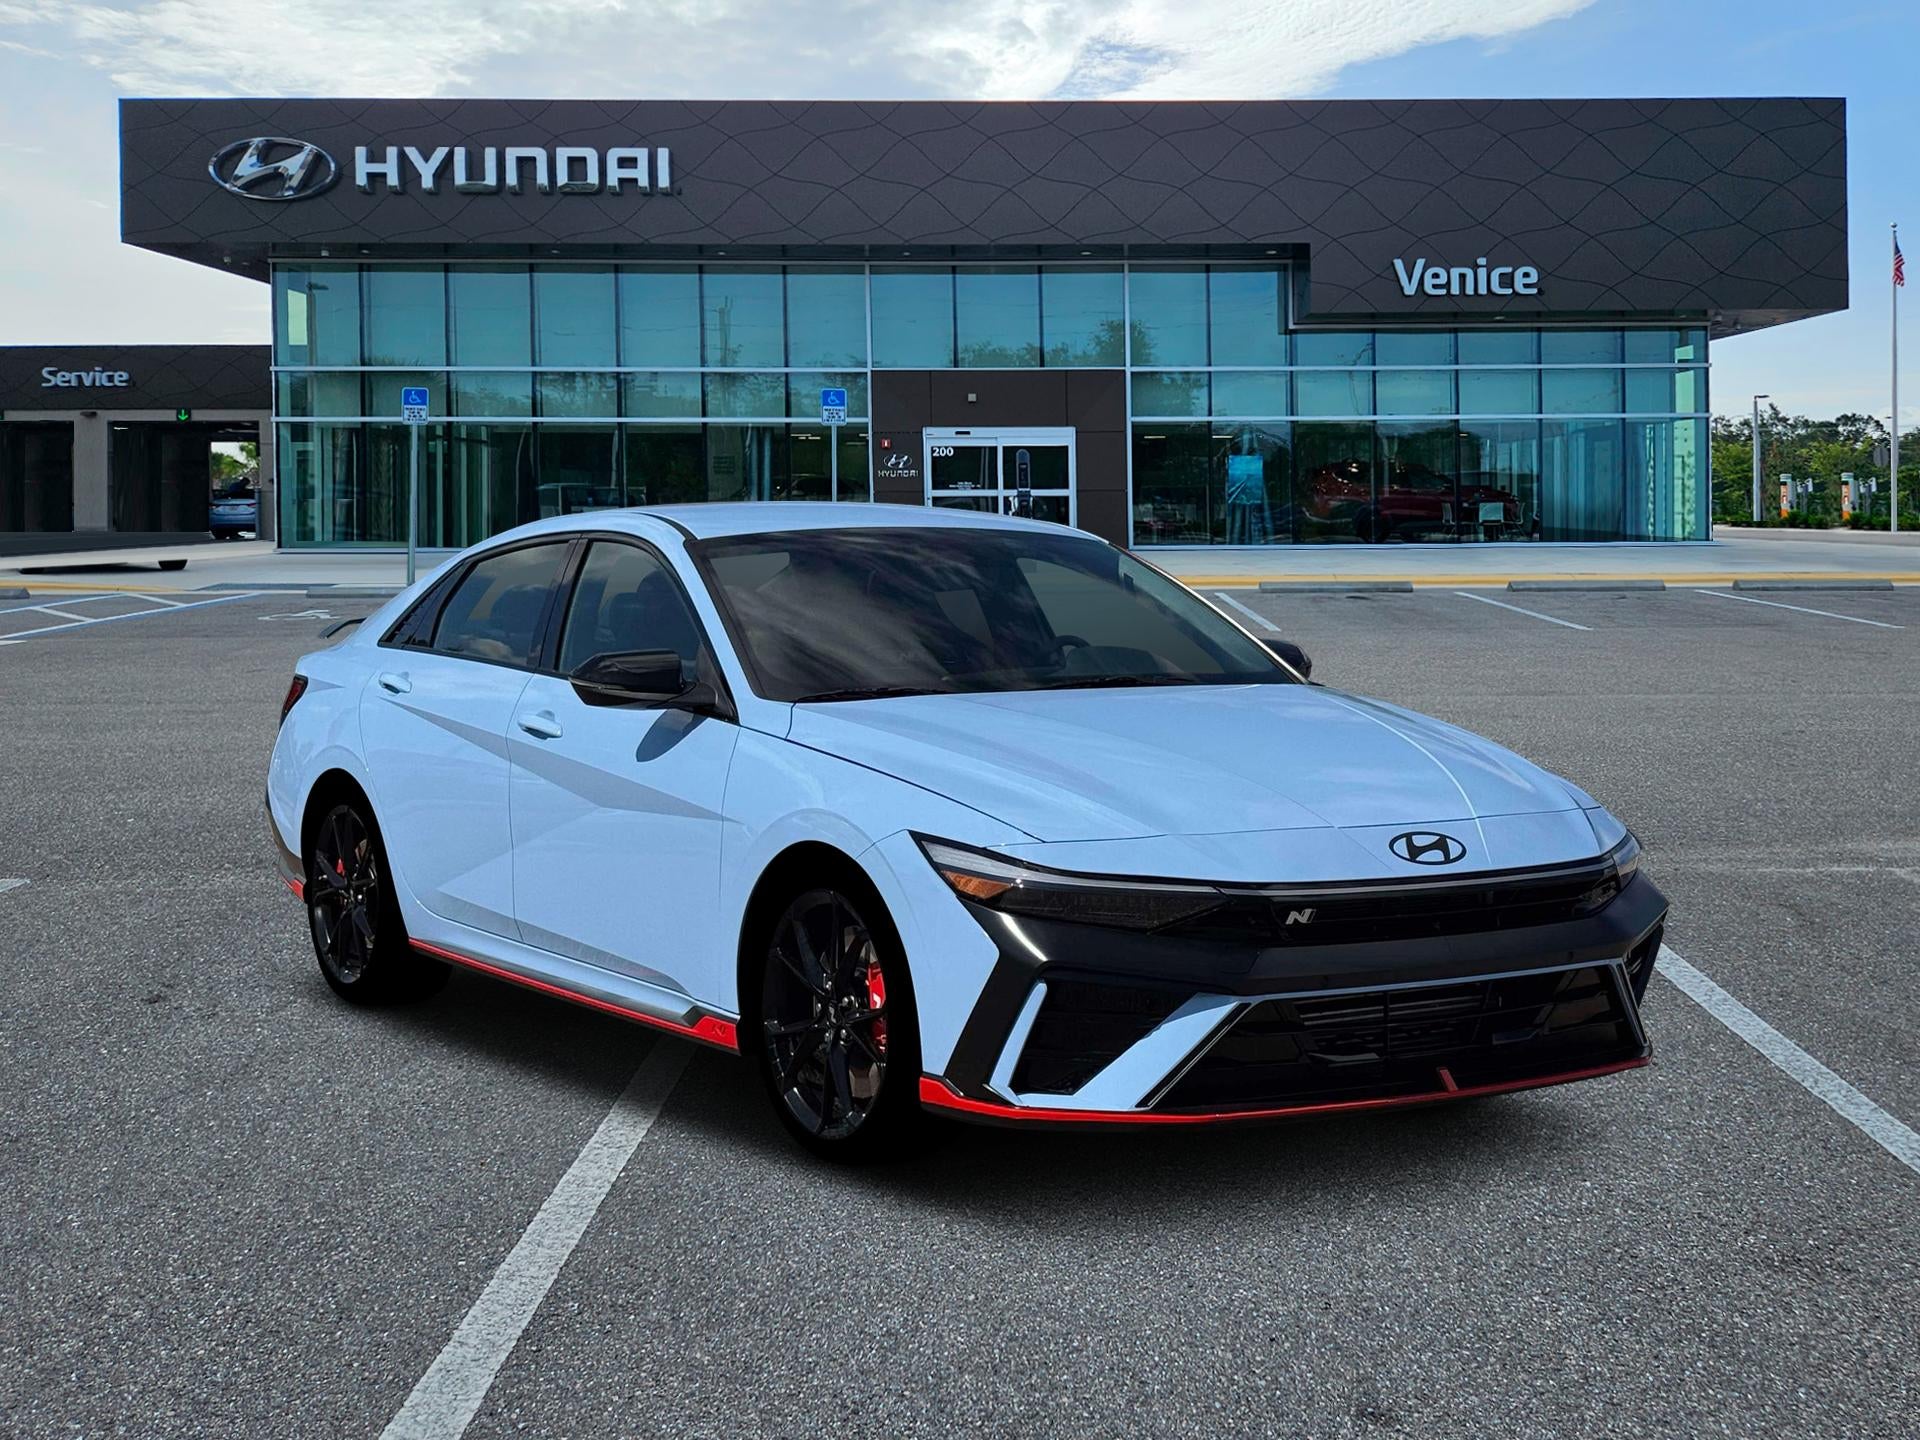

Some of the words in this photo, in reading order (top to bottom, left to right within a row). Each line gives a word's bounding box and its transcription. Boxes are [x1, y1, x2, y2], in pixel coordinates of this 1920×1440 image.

[354, 145, 671, 194] HYUNDAI
[1392, 256, 1540, 296] Venice
[40, 366, 129, 387] Service
[932, 446, 954, 457] 200
[877, 469, 919, 478] HYUNDAI
